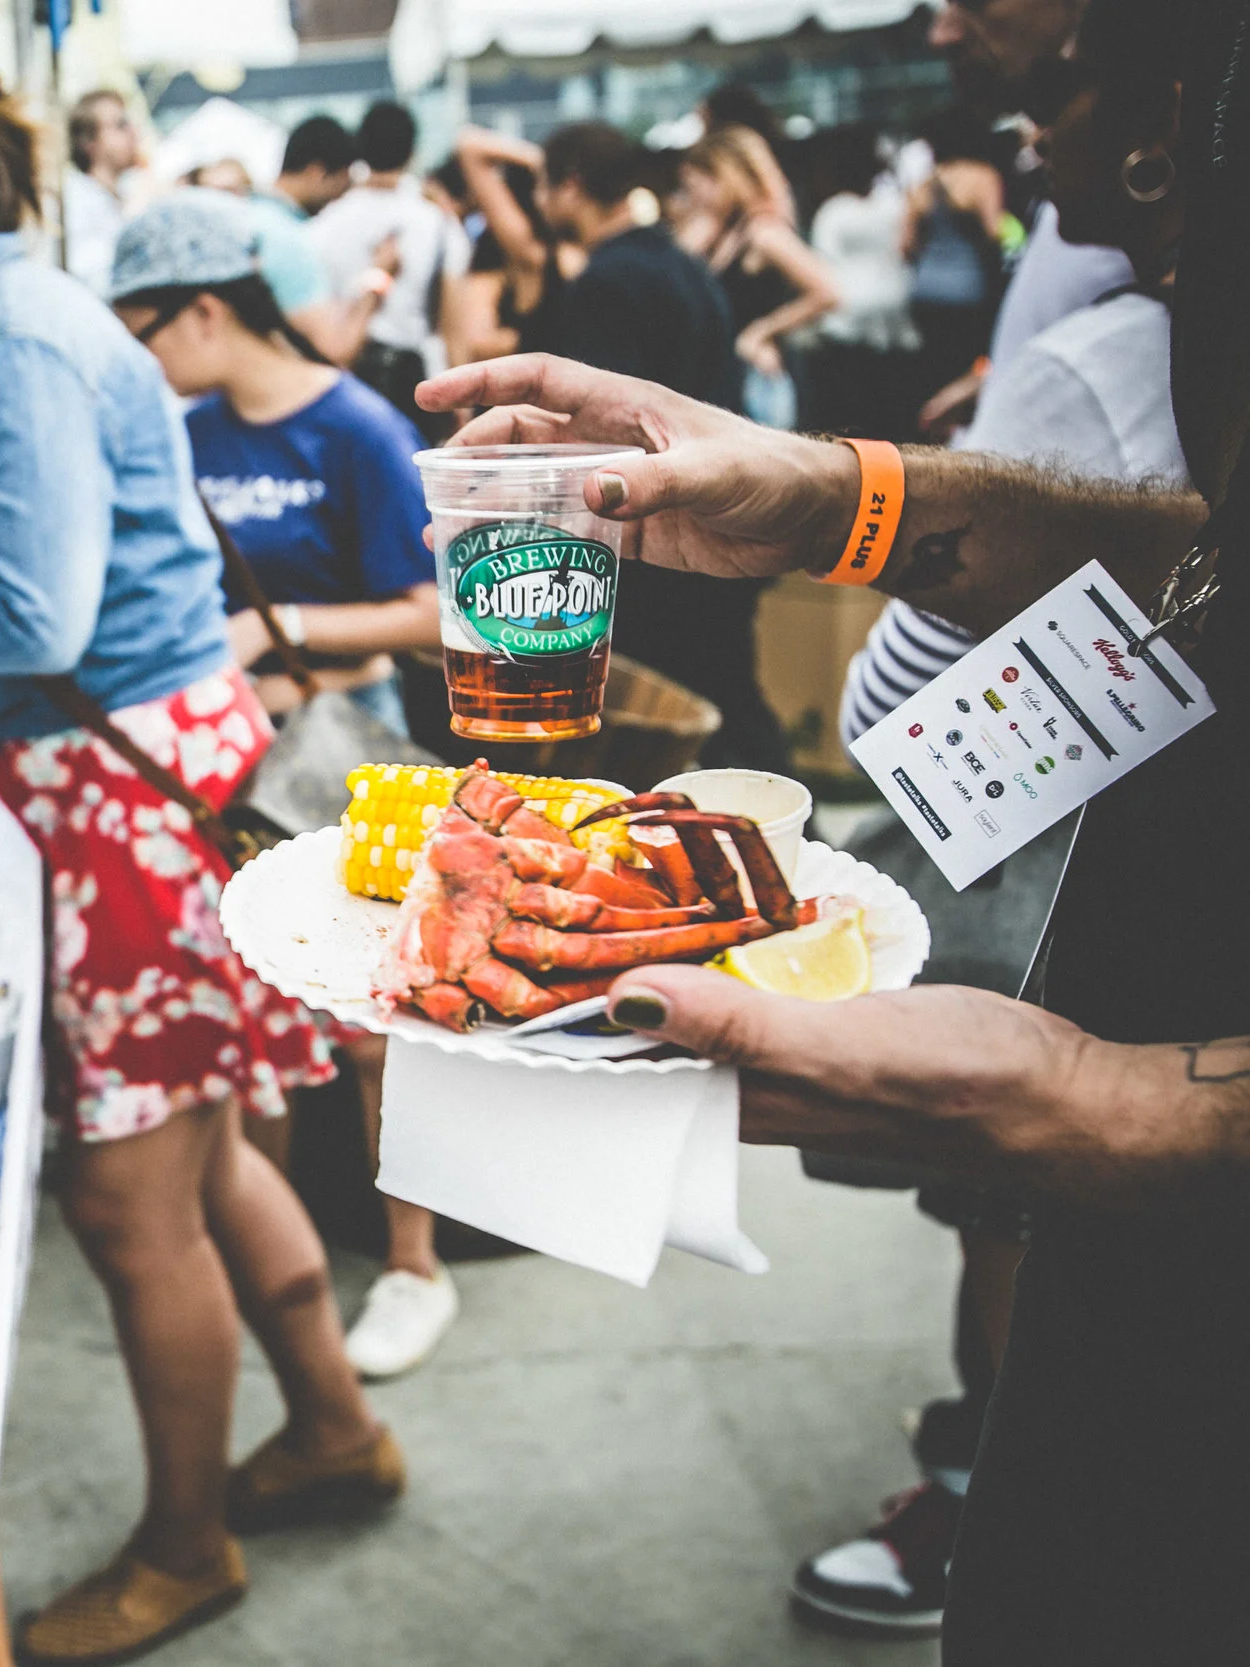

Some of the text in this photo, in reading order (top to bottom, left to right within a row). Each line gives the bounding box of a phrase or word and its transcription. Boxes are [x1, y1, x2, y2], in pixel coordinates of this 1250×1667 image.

[851, 492, 886, 569] 21 PLUS
[488, 546, 607, 581] BREWING
[474, 582, 543, 619] BLUE
[551, 575, 612, 617] POINT
[500, 623, 593, 650] COMPANY
[1056, 629, 1091, 671] SQUARESPACE
[1092, 638, 1136, 682] Kellogg's
[952, 780, 973, 802] JURA
[1020, 780, 1038, 799] MOO
